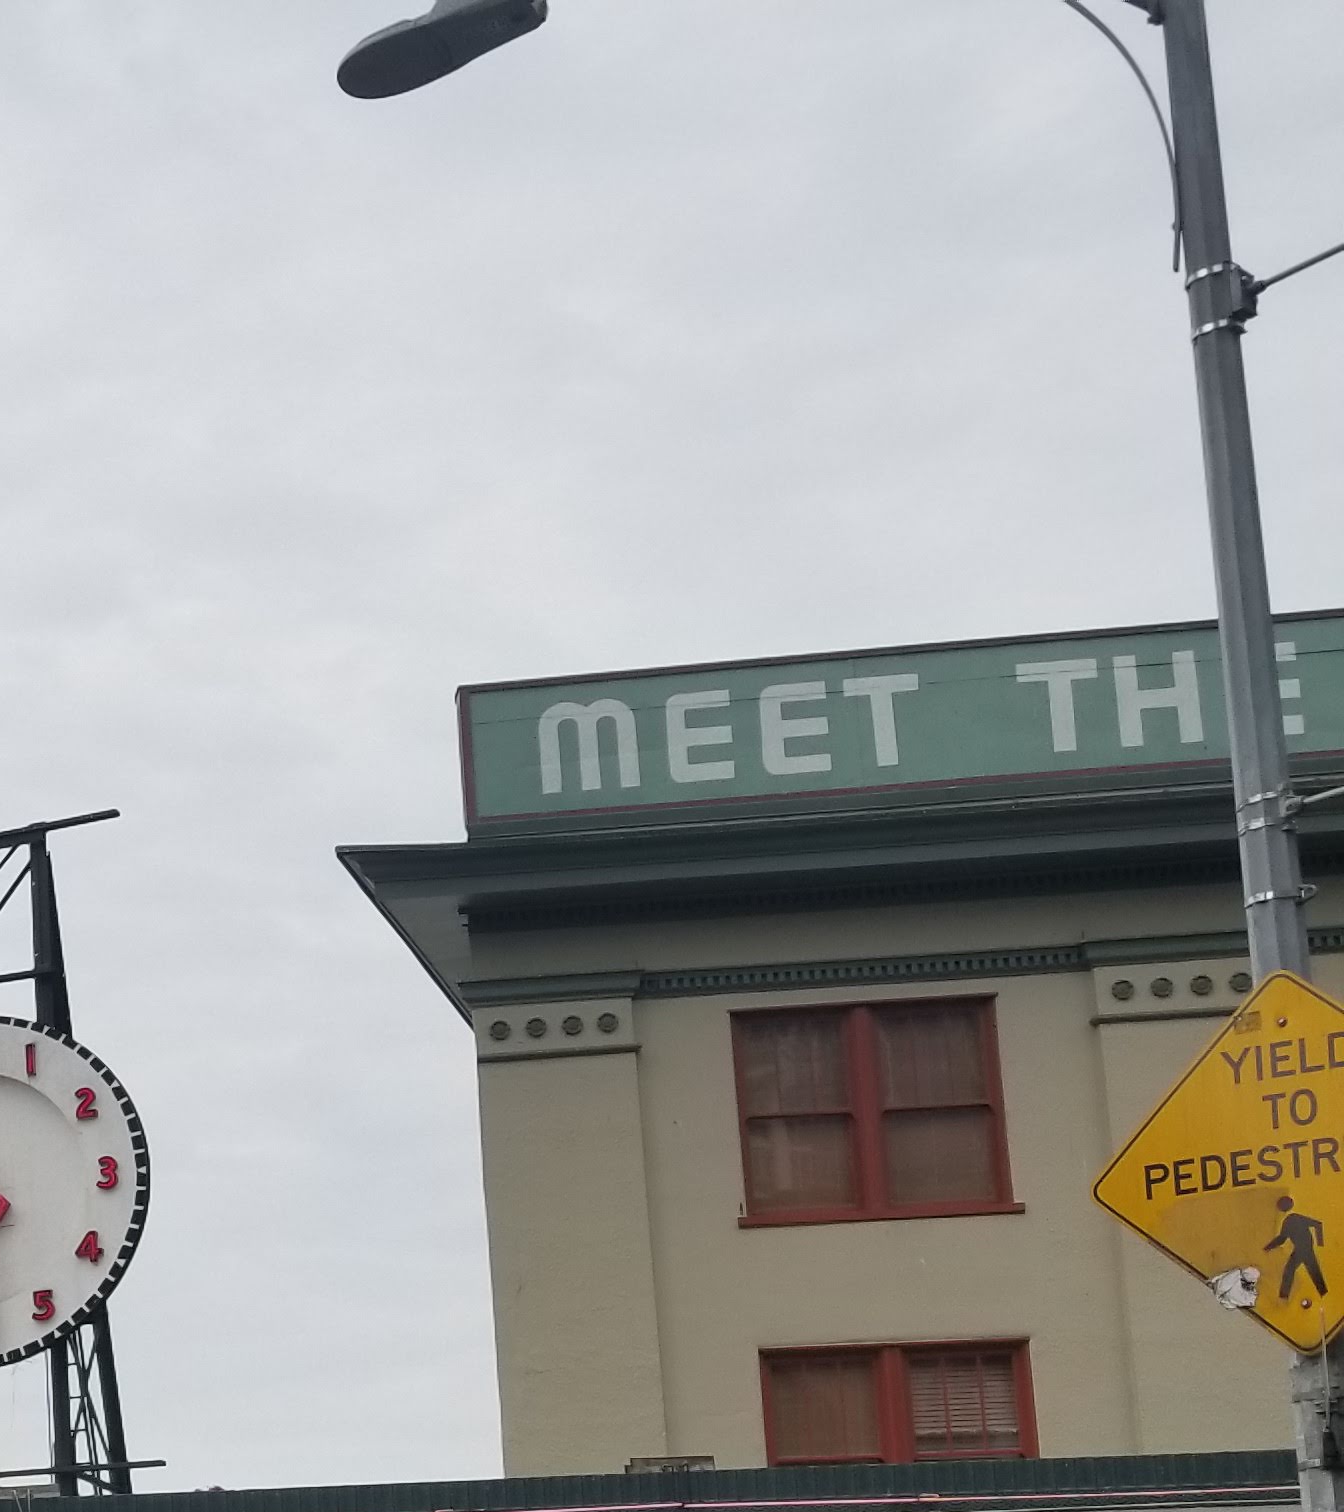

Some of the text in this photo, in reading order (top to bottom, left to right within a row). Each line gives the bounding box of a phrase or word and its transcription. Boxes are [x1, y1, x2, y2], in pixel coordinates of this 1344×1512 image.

[539, 672, 919, 795] MEET
[25, 1043, 37, 1077] 1
[75, 1087, 99, 1120] 2
[1262, 1088, 1318, 1130] TO
[96, 1156, 119, 1190] 3
[75, 1230, 104, 1265] 4
[32, 1289, 57, 1322] 5
